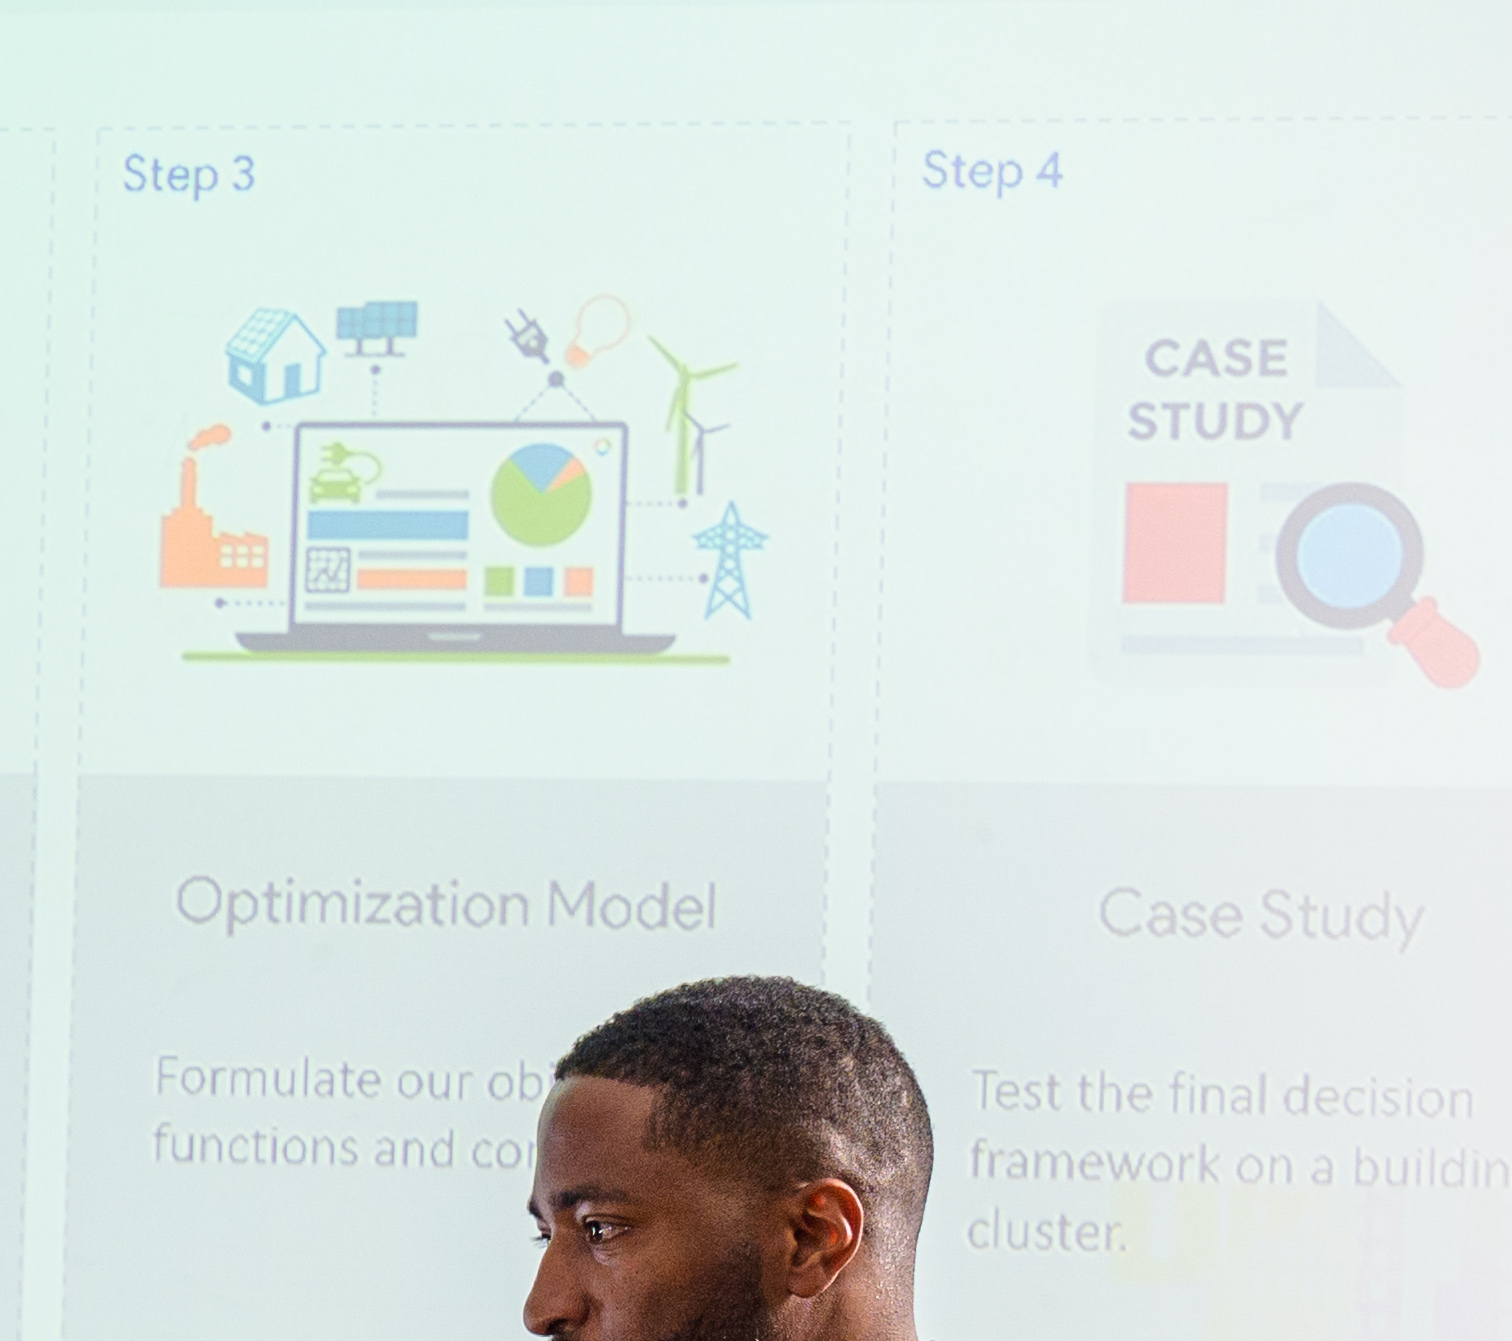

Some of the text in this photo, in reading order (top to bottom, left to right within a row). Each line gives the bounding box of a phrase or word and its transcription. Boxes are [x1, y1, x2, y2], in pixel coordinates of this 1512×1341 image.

[123, 152, 255, 202] Step 3
[923, 148, 1063, 199] Step 4
[1145, 337, 1287, 378] CASE
[1129, 401, 1303, 441] STUDY
[176, 875, 716, 938] Optimization Model
[1100, 886, 1424, 953] Case Study
[158, 1055, 381, 1099] Formulate
[397, 1070, 472, 1100] our
[973, 1069, 1472, 1118] Test the final decision
[154, 1122, 358, 1167] functions
[375, 1129, 454, 1169] and
[971, 1138, 1219, 1183] framework
[1236, 1154, 1292, 1184] on
[1311, 1155, 1333, 1186] a
[967, 1207, 1126, 1252] cluster.
